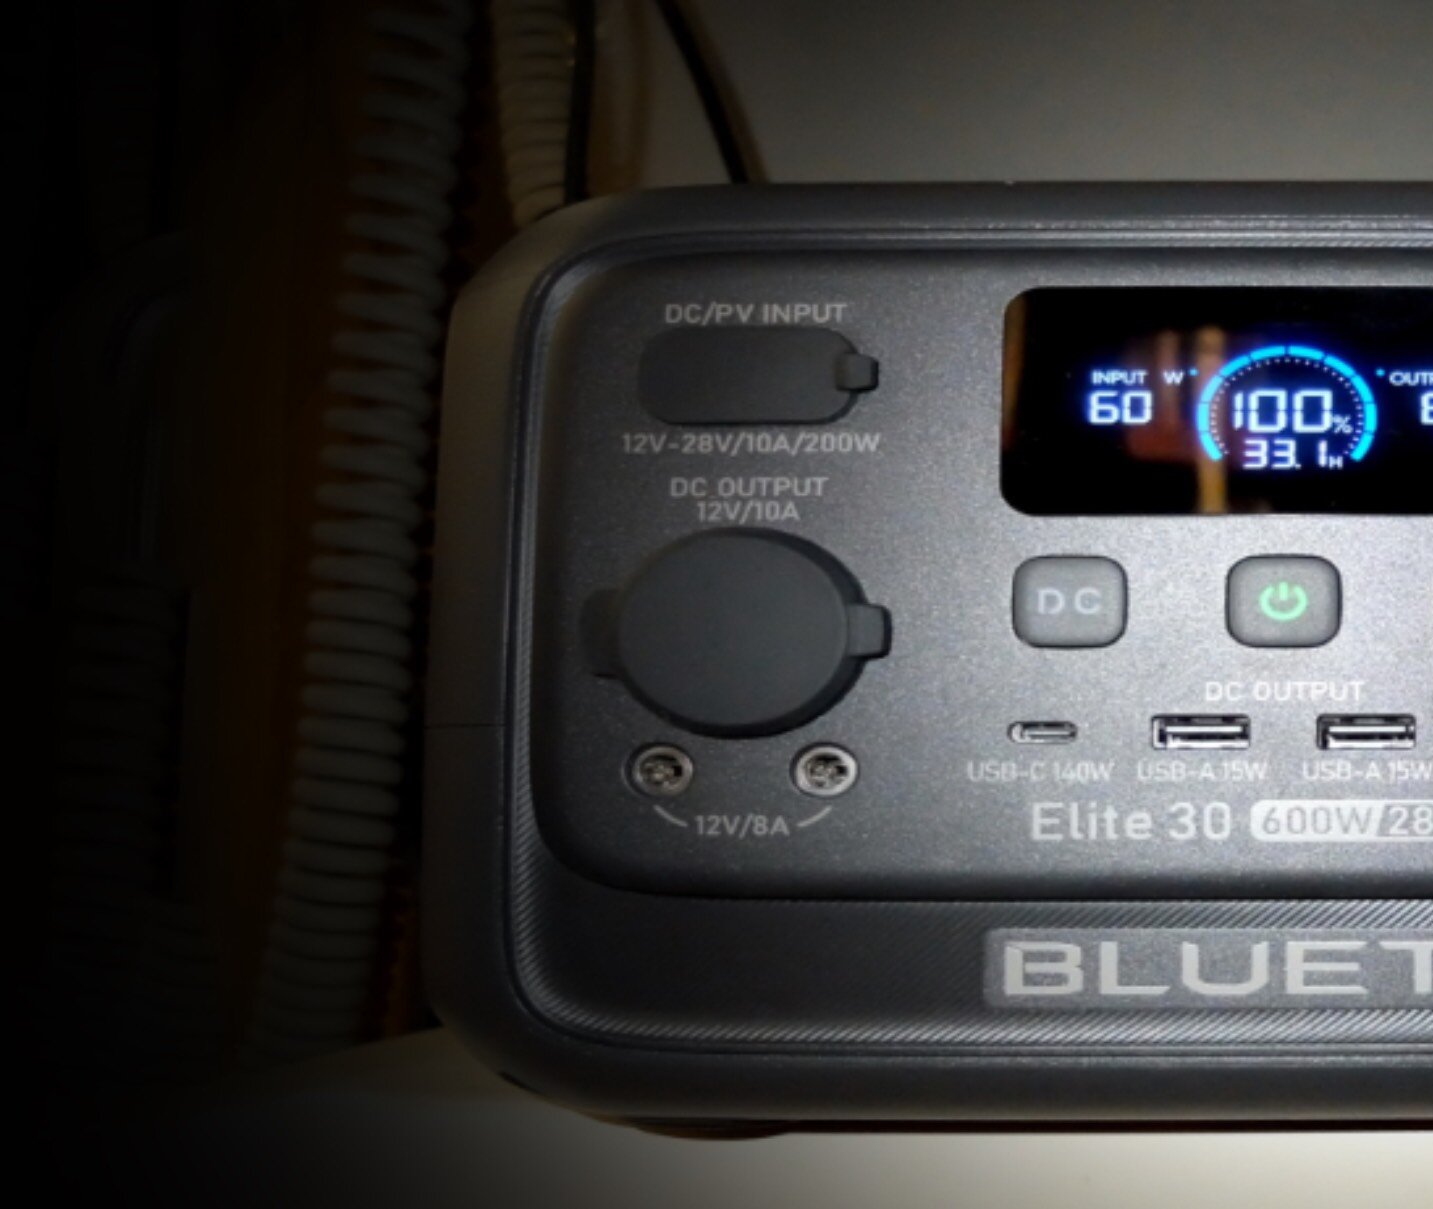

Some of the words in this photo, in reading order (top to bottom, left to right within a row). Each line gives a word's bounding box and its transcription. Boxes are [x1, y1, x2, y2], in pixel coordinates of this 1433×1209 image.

[664, 302, 754, 326] DC/PV
[763, 302, 849, 324] INPUT
[1091, 370, 1148, 385] INPUT
[1162, 371, 1184, 385] W
[1088, 391, 1152, 424] 60
[622, 432, 881, 457] 12V-28V/10A/200W
[670, 476, 709, 498] DC
[717, 476, 830, 498] OUTPUT
[696, 500, 799, 524] 12V/10A
[1036, 586, 1101, 615] DC
[1205, 681, 1243, 702] DC
[1252, 681, 1366, 702] OUTPUT
[967, 761, 1046, 783] USB-C
[1053, 761, 1116, 784] 140W
[1136, 760, 1215, 782] USB-A
[1219, 760, 1270, 782] 15W
[1302, 760, 1381, 782] USB-A
[1387, 760, 1433, 784] 15W
[694, 814, 790, 839] 12V/8A
[1030, 802, 1154, 841] Elite
[1168, 802, 1232, 840] 30
